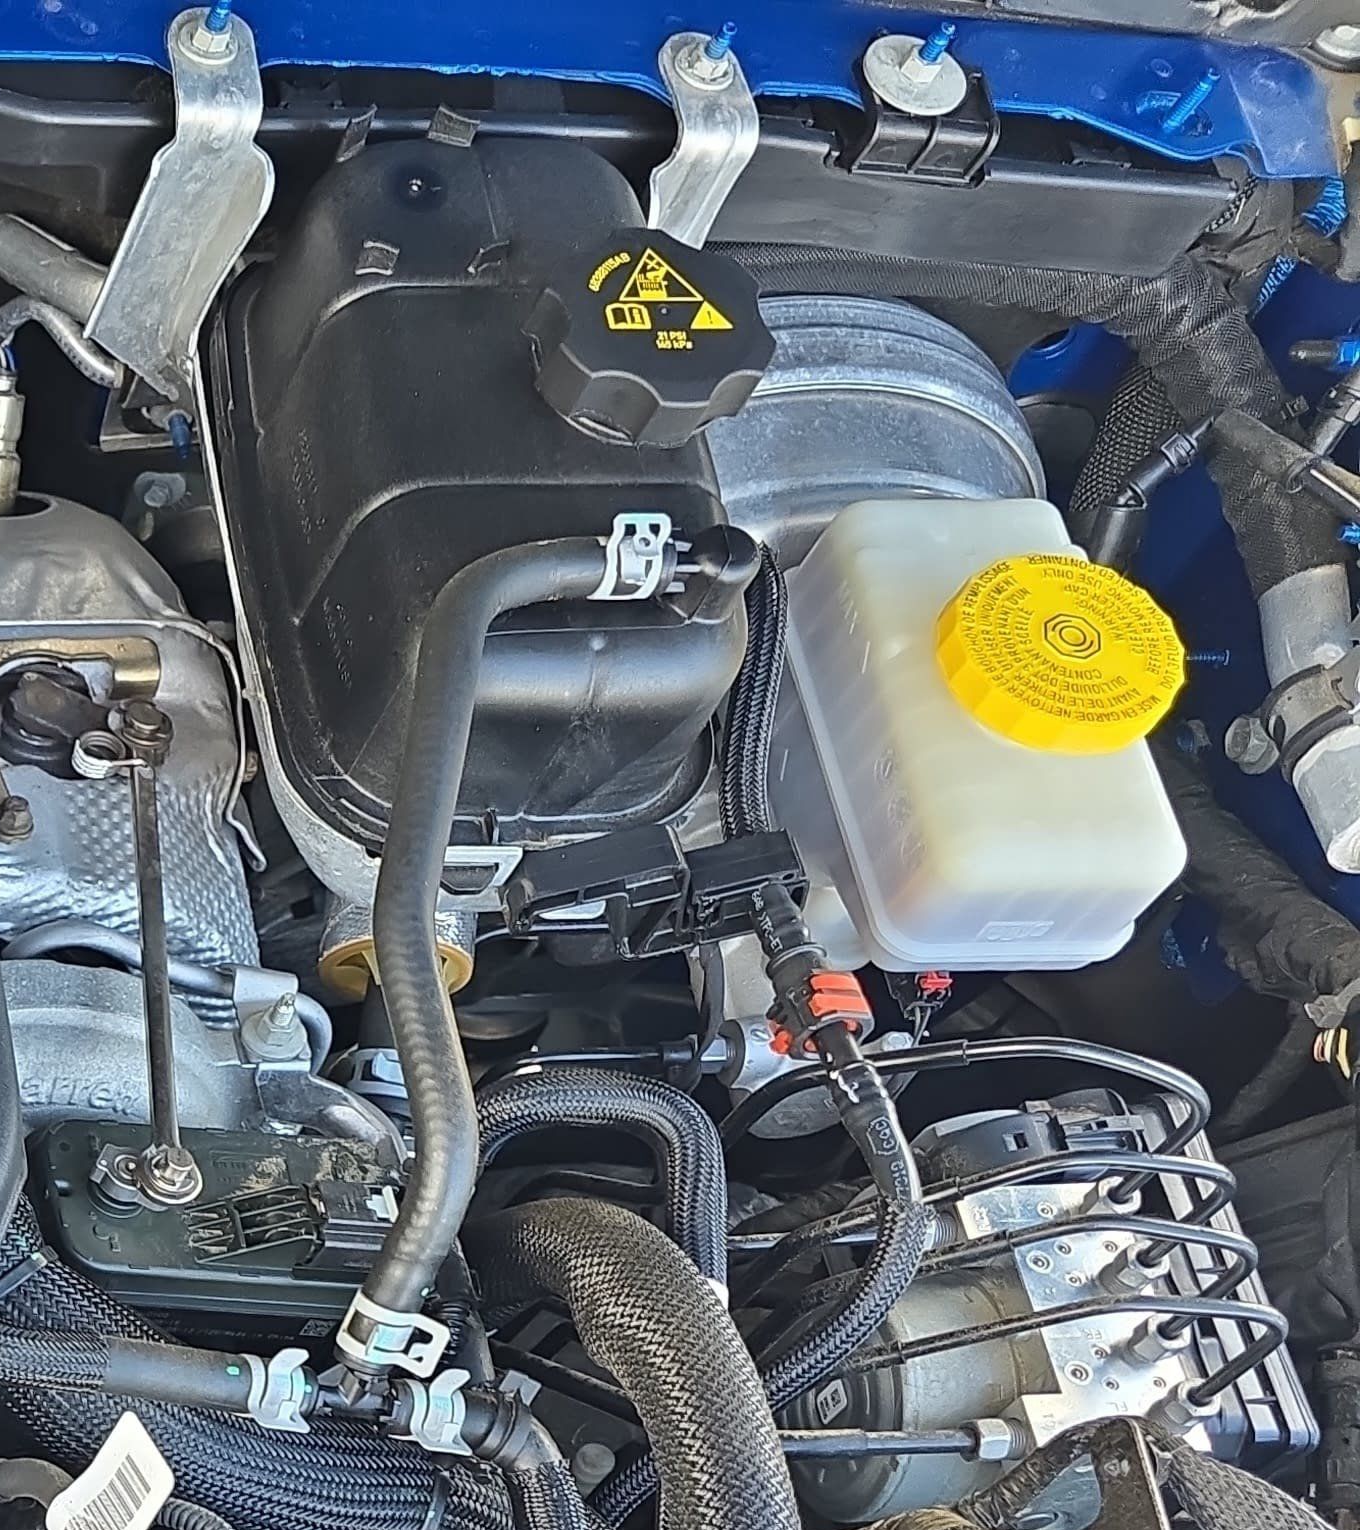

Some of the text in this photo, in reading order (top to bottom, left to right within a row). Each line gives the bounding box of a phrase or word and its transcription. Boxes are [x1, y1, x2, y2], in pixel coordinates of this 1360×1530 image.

[1026, 555, 1095, 572] CONTAINER
[1040, 568, 1073, 579] ONLY
[1077, 573, 1102, 589] USE
[1063, 583, 1144, 654] CLEAN FILLER CAP
[997, 605, 1023, 663] PROVENANT
[962, 623, 997, 673] BOUCHON
[1146, 636, 1161, 674] BEFORE
[1024, 646, 1101, 680] CONTENANT
[1032, 669, 1058, 687] DOT
[1061, 680, 1109, 694] LIQUIDE
[1160, 669, 1176, 688] DOT
[1007, 685, 1071, 717] NETTOYER
[1067, 695, 1084, 707] LE
[1085, 697, 1101, 708] DE
[1106, 687, 1140, 707] AVANT
[1136, 694, 1160, 713] MISE
[1119, 706, 1136, 719] EN
